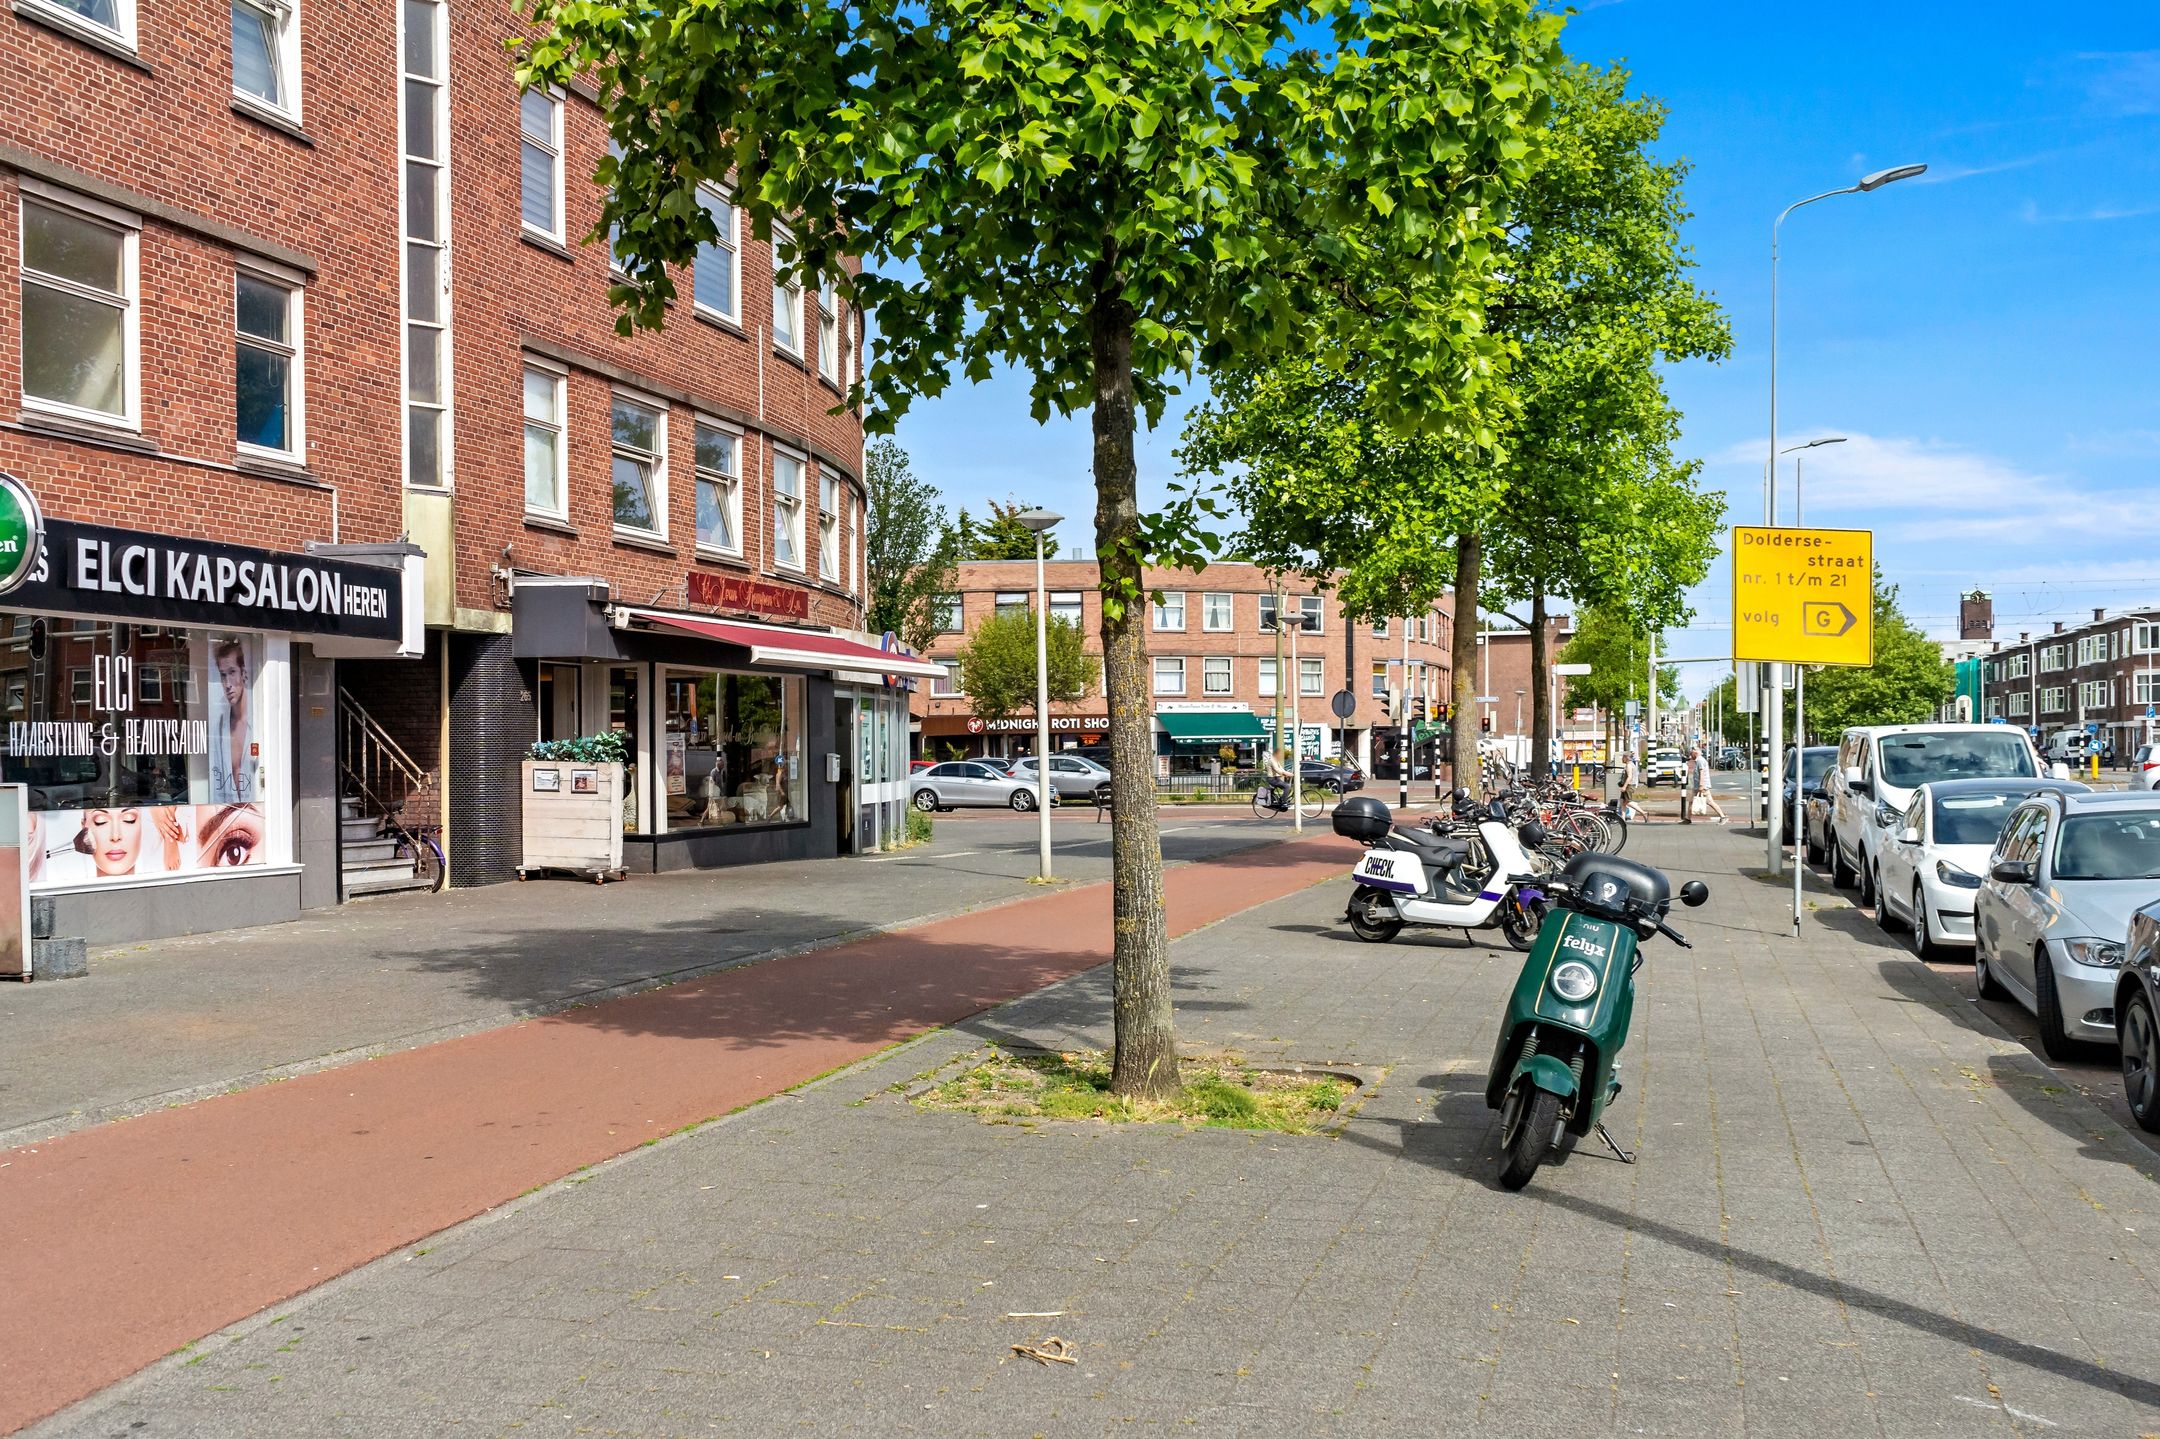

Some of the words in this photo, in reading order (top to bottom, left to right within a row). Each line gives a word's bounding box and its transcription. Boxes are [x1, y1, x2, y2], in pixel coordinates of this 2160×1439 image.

[1742, 532, 1832, 547] Dolderse-
[1807, 554, 1864, 568] straat
[77, 537, 155, 597] ELCI
[166, 549, 341, 615] KAPSALON
[344, 583, 387, 618] HEREN
[1743, 573, 1766, 585] nr.
[1775, 572, 1781, 585] 1
[1787, 572, 1822, 586] t/m
[1830, 573, 1847, 587] 21
[1743, 611, 1779, 627] volg
[1816, 610, 1831, 628] G
[94, 654, 134, 712] ELCI
[986, 718, 1040, 731] MIDNIGH
[1052, 718, 1080, 729] ROTI
[1084, 718, 1110, 729] SHO
[9, 720, 94, 757] HAARSTYLING
[101, 722, 120, 756] &
[125, 718, 208, 756] BEAUTYSALON
[1562, 935, 1606, 957] felyx
